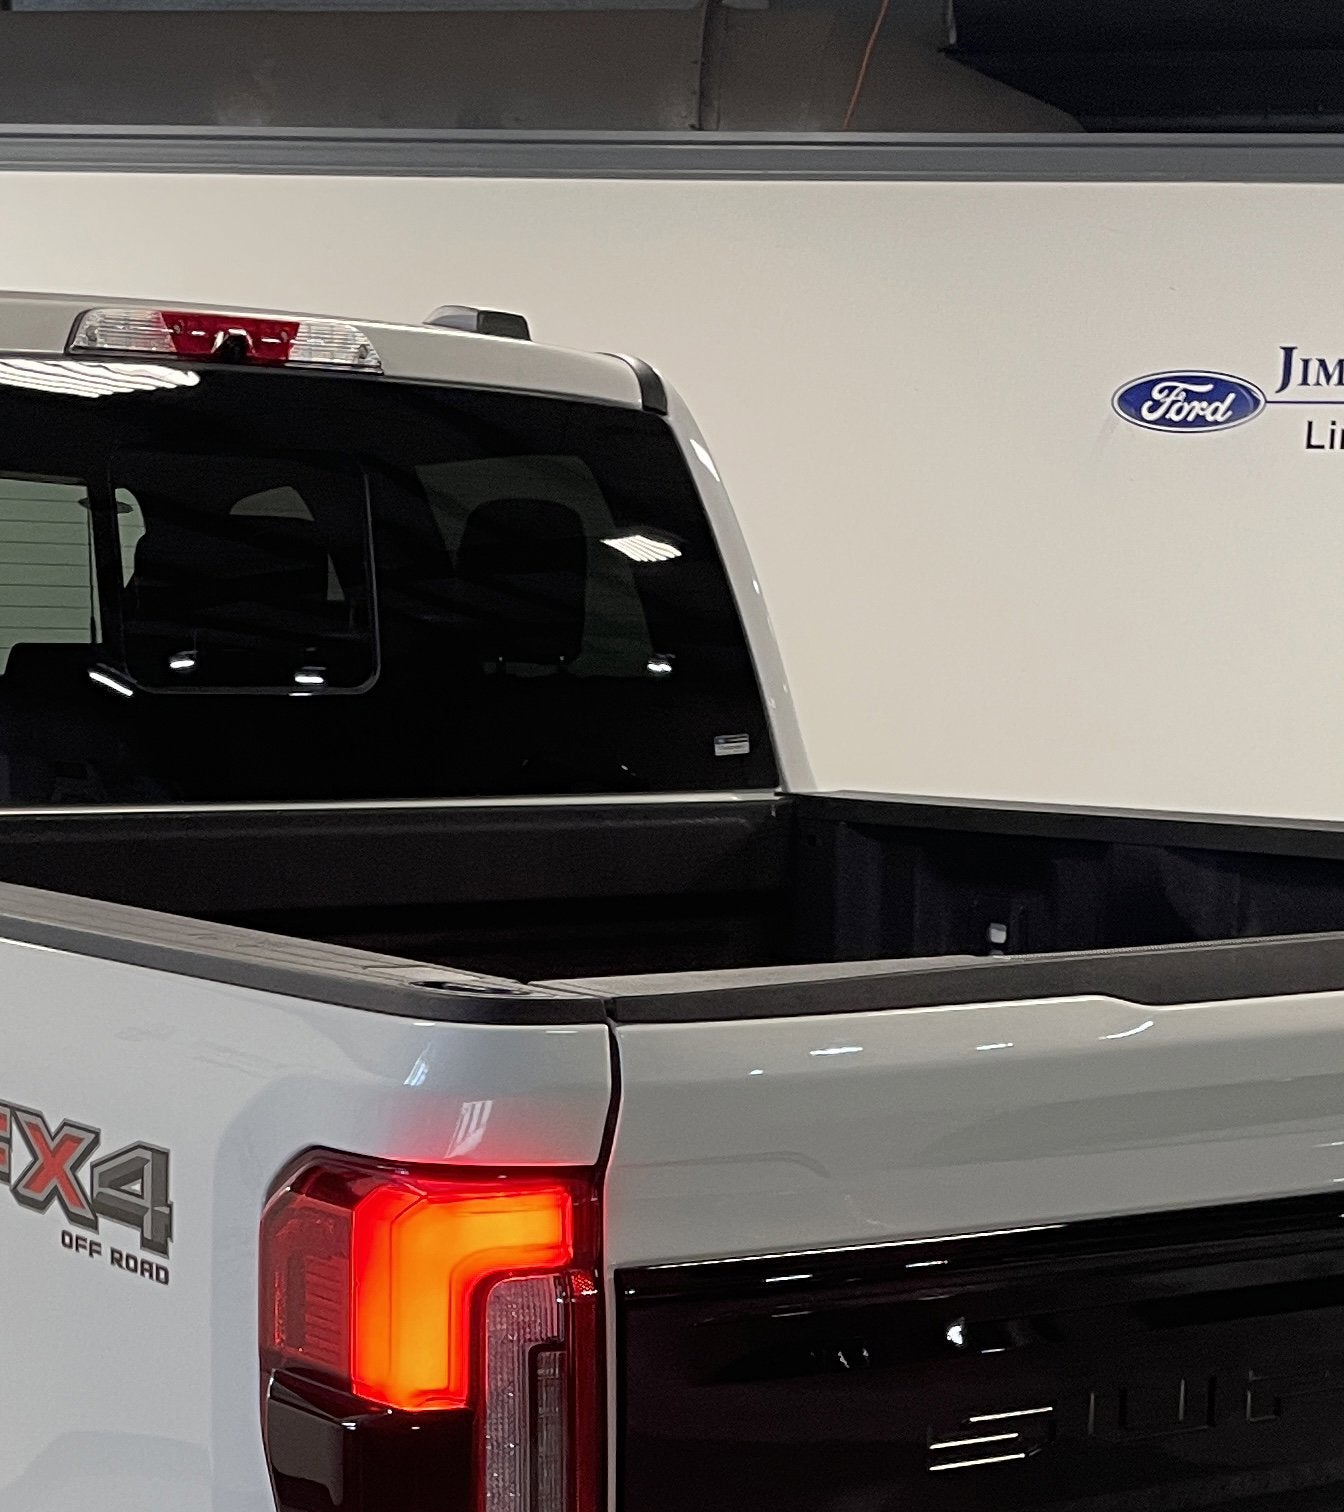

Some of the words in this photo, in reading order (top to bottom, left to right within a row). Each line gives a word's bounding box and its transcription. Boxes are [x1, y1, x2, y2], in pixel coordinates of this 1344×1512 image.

[1140, 380, 1236, 425] Ford
[61, 1229, 103, 1258] OFF
[109, 1246, 170, 1285] ROAD
